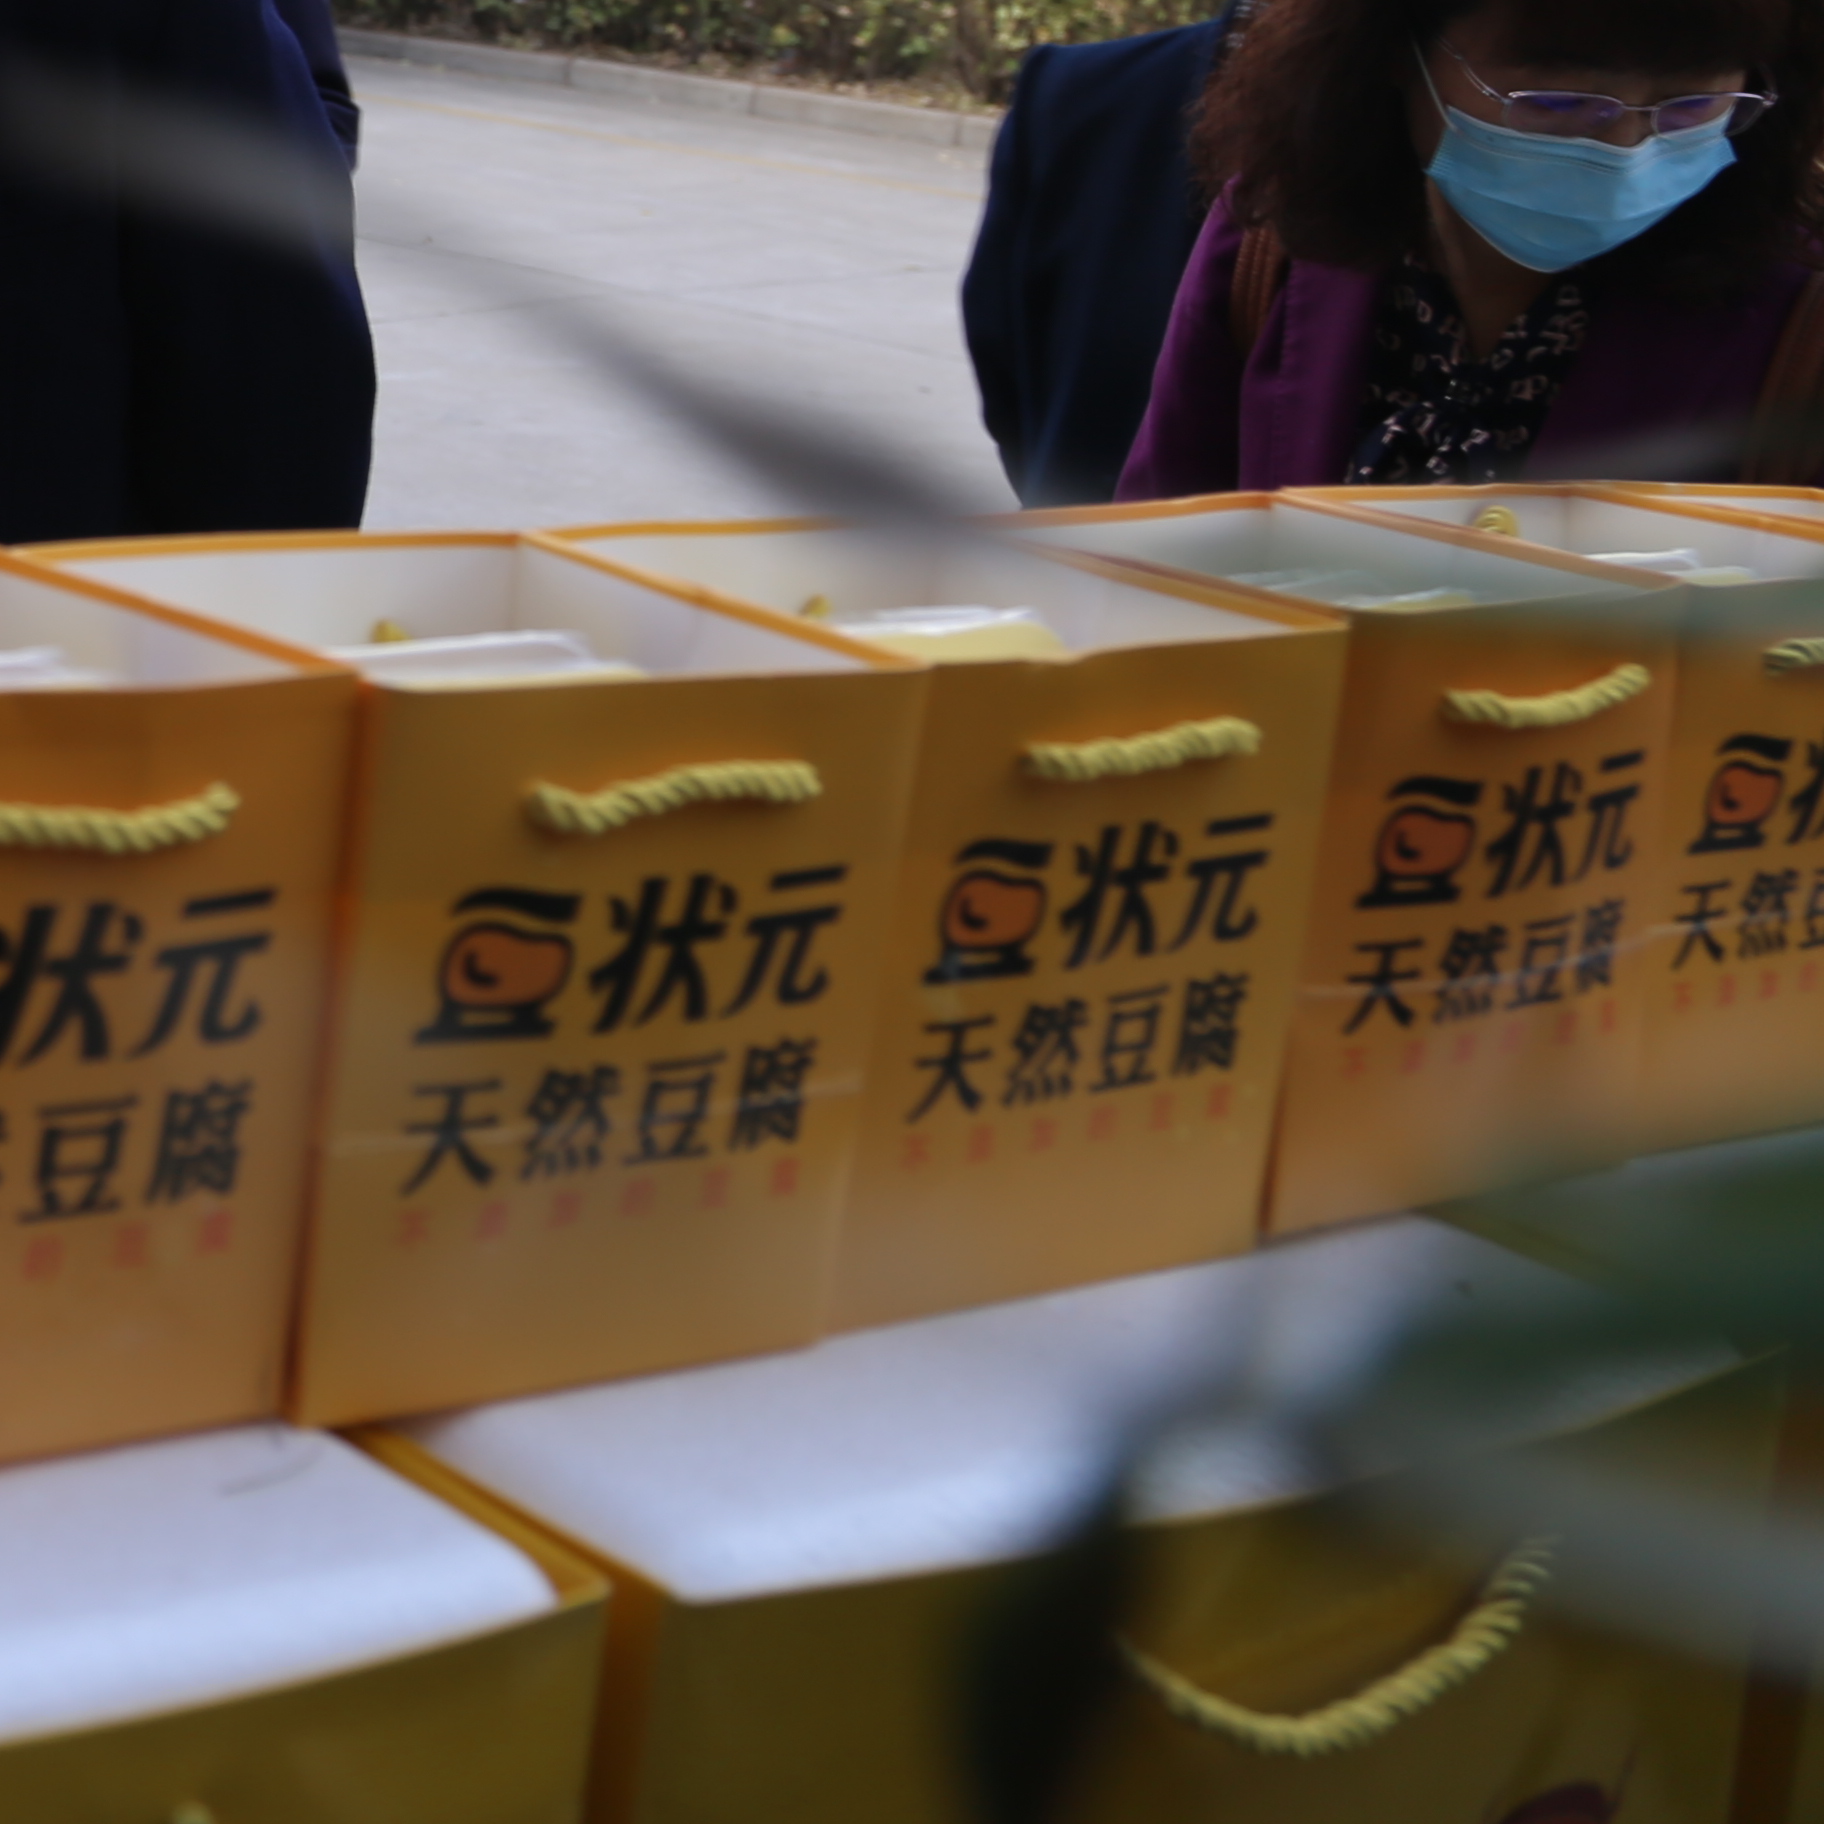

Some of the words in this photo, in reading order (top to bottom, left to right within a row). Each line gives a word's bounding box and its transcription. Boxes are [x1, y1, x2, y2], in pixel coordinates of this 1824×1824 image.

[923, 813, 1274, 986] 豆状元
[1355, 751, 1645, 909] 豆状元
[412, 865, 846, 1045] 豆状元
[1342, 898, 1624, 1035] 天然豆腐
[401, 1038, 816, 1196] 天然豆腐
[905, 971, 1249, 1123] 天然豆腐
